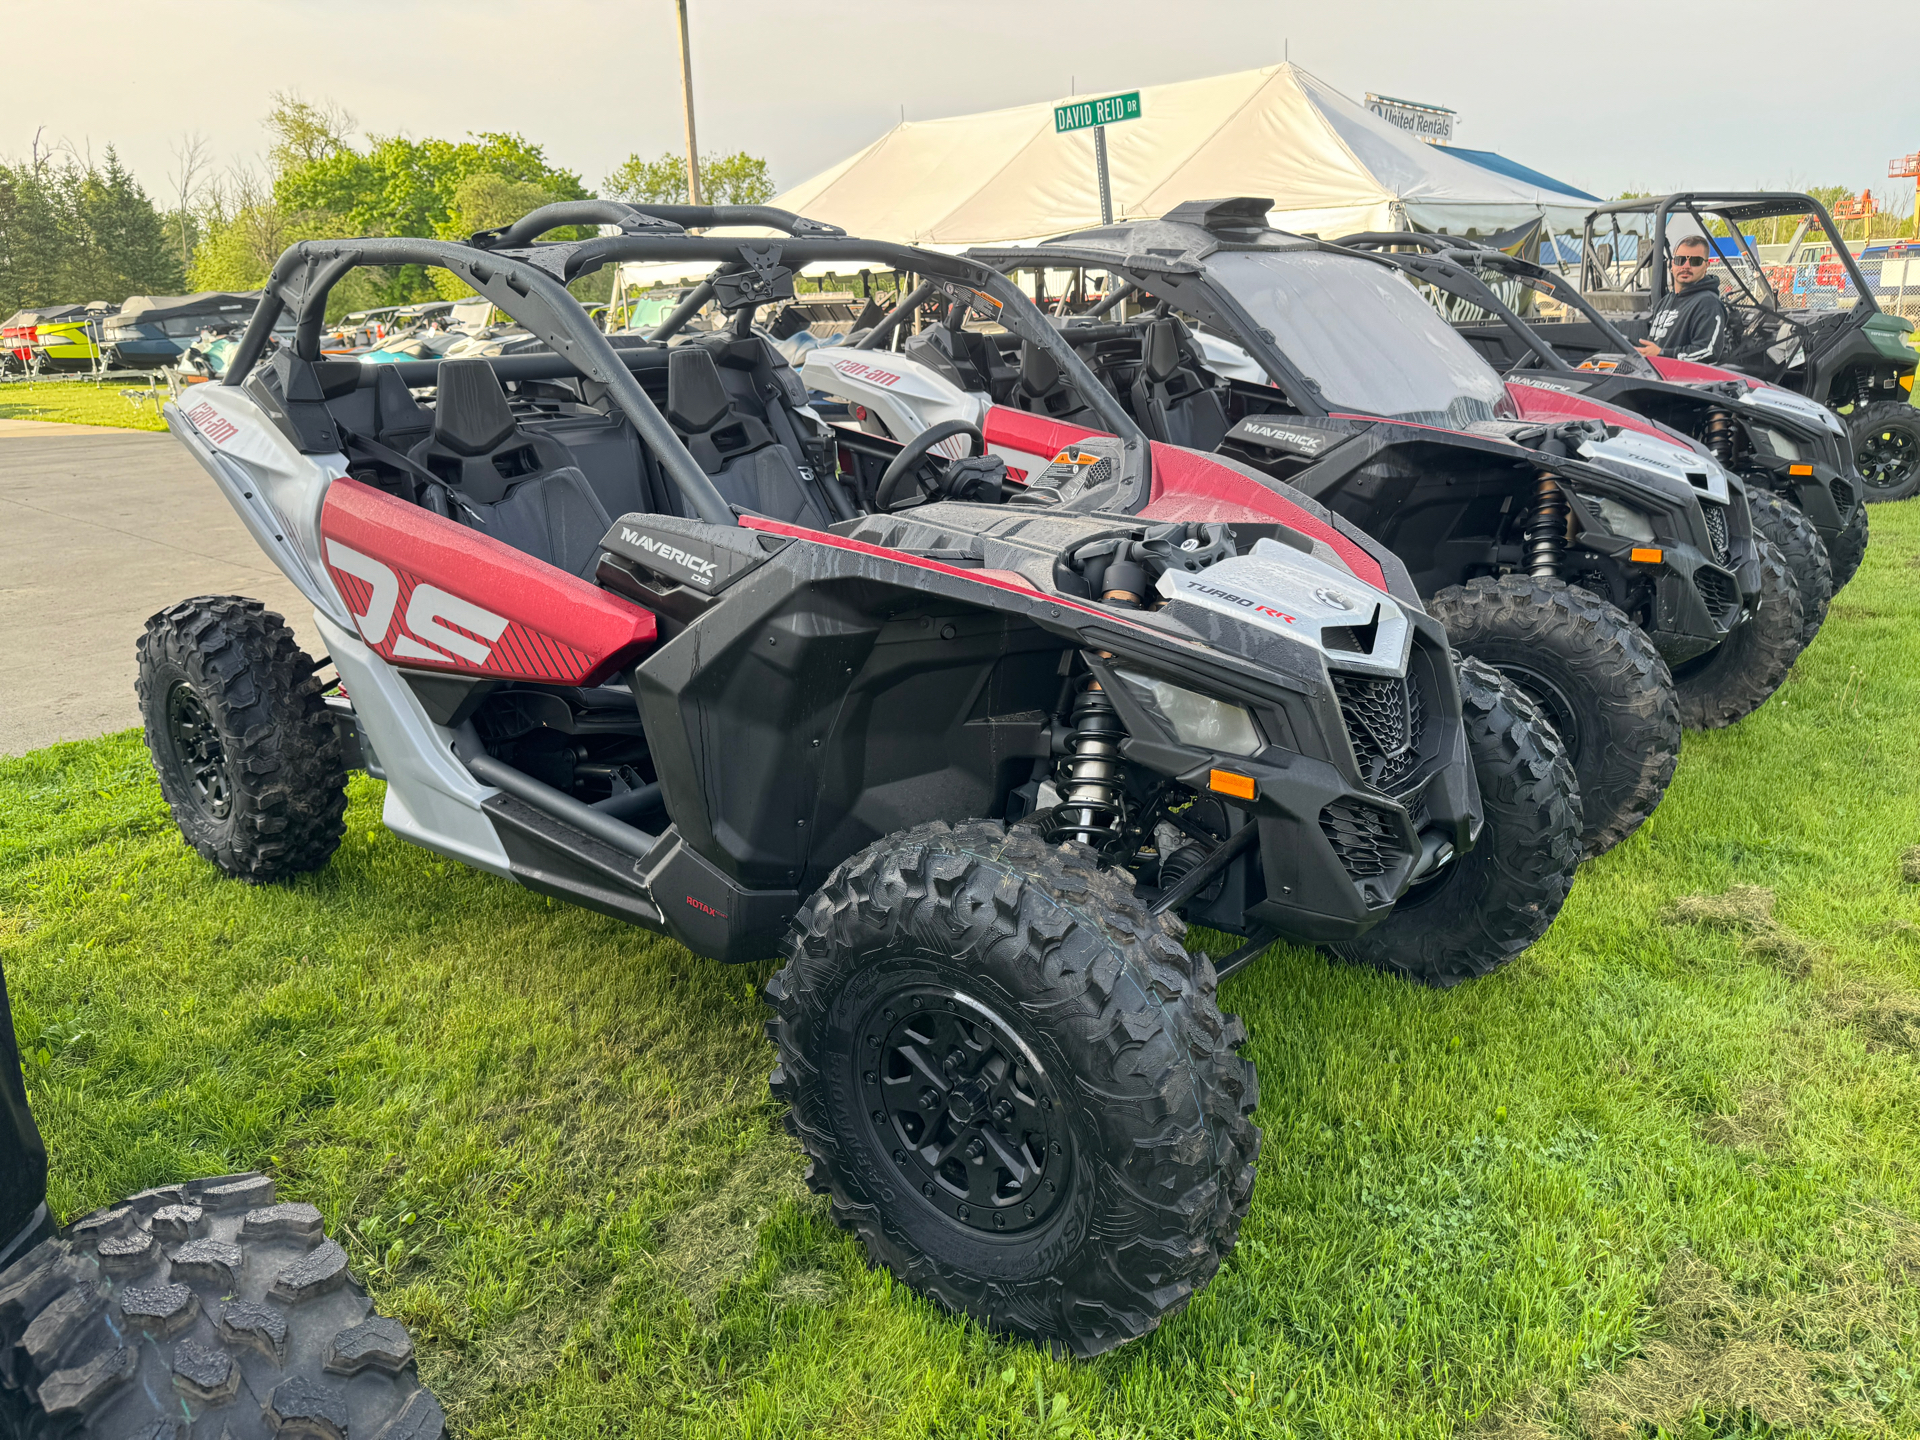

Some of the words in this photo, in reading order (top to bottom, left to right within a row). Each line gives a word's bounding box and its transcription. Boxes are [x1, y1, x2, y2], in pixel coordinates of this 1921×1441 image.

[1057, 104, 1092, 130] DAVID
[1096, 98, 1124, 123] REID
[1127, 100, 1137, 112] DR
[1384, 107, 1416, 131] United
[1416, 114, 1450, 136] Rentals
[834, 359, 901, 387] can-am
[1508, 375, 1571, 392] MAVERICK
[188, 401, 239, 445] can-am
[1243, 422, 1321, 448] MAVERICK
[1299, 446, 1316, 454] DS
[1627, 452, 1671, 469] TURBO
[620, 526, 718, 578] MAVERICK
[690, 573, 712, 586] DS
[1186, 581, 1255, 608] TURBO
[1254, 605, 1297, 625] RR
[686, 895, 716, 917] ROTAX
